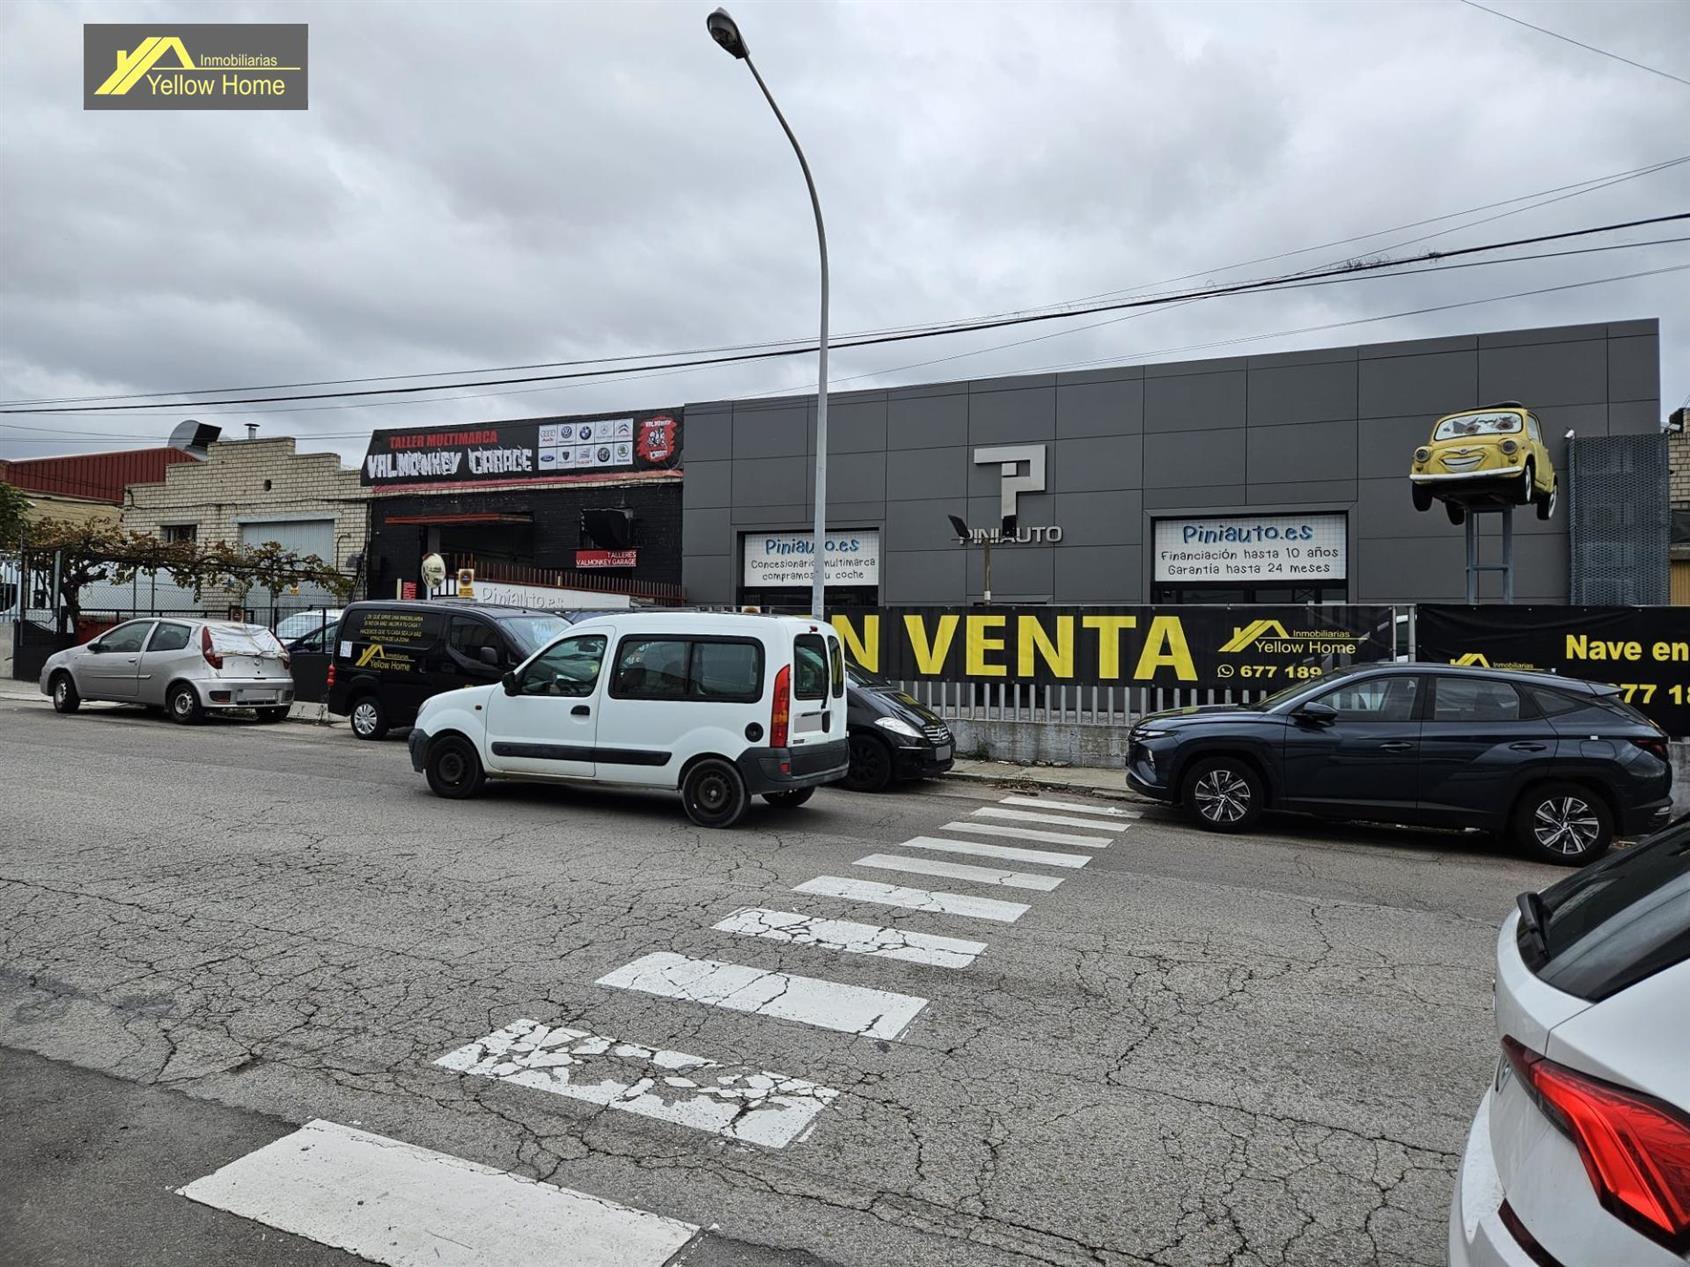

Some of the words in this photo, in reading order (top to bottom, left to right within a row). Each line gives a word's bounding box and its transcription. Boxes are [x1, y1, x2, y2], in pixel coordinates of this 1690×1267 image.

[389, 435, 427, 449] TALLER
[427, 429, 499, 448] MULTIMARCA
[366, 449, 463, 479] VALMONKEY
[468, 447, 533, 475] GARAGE
[1183, 524, 1313, 544] Piniauto.es
[765, 538, 860, 555] Piniauo.es
[1160, 549, 1238, 561] Financiación
[1244, 549, 1279, 559] hasta
[1286, 548, 1300, 559] 10
[1306, 546, 1339, 558] años
[835, 569, 864, 579] coche
[1168, 563, 1220, 576] Garantía
[1226, 563, 1261, 574] hasta
[1267, 563, 1283, 573] 24
[1289, 563, 1331, 573] meses
[1293, 629, 1351, 638] Inmobiliarias
[801, 614, 880, 673] N
[903, 614, 1199, 682] VENTA
[1254, 640, 1304, 654] Yellow
[1309, 641, 1357, 655] Home
[1566, 634, 1643, 661] Nave
[1652, 641, 1690, 661] en
[1240, 665, 1278, 678] 677
[1284, 666, 1323, 679] 189
[1493, 661, 1534, 669] Inmobiliarias
[1612, 683, 1658, 704] 77
